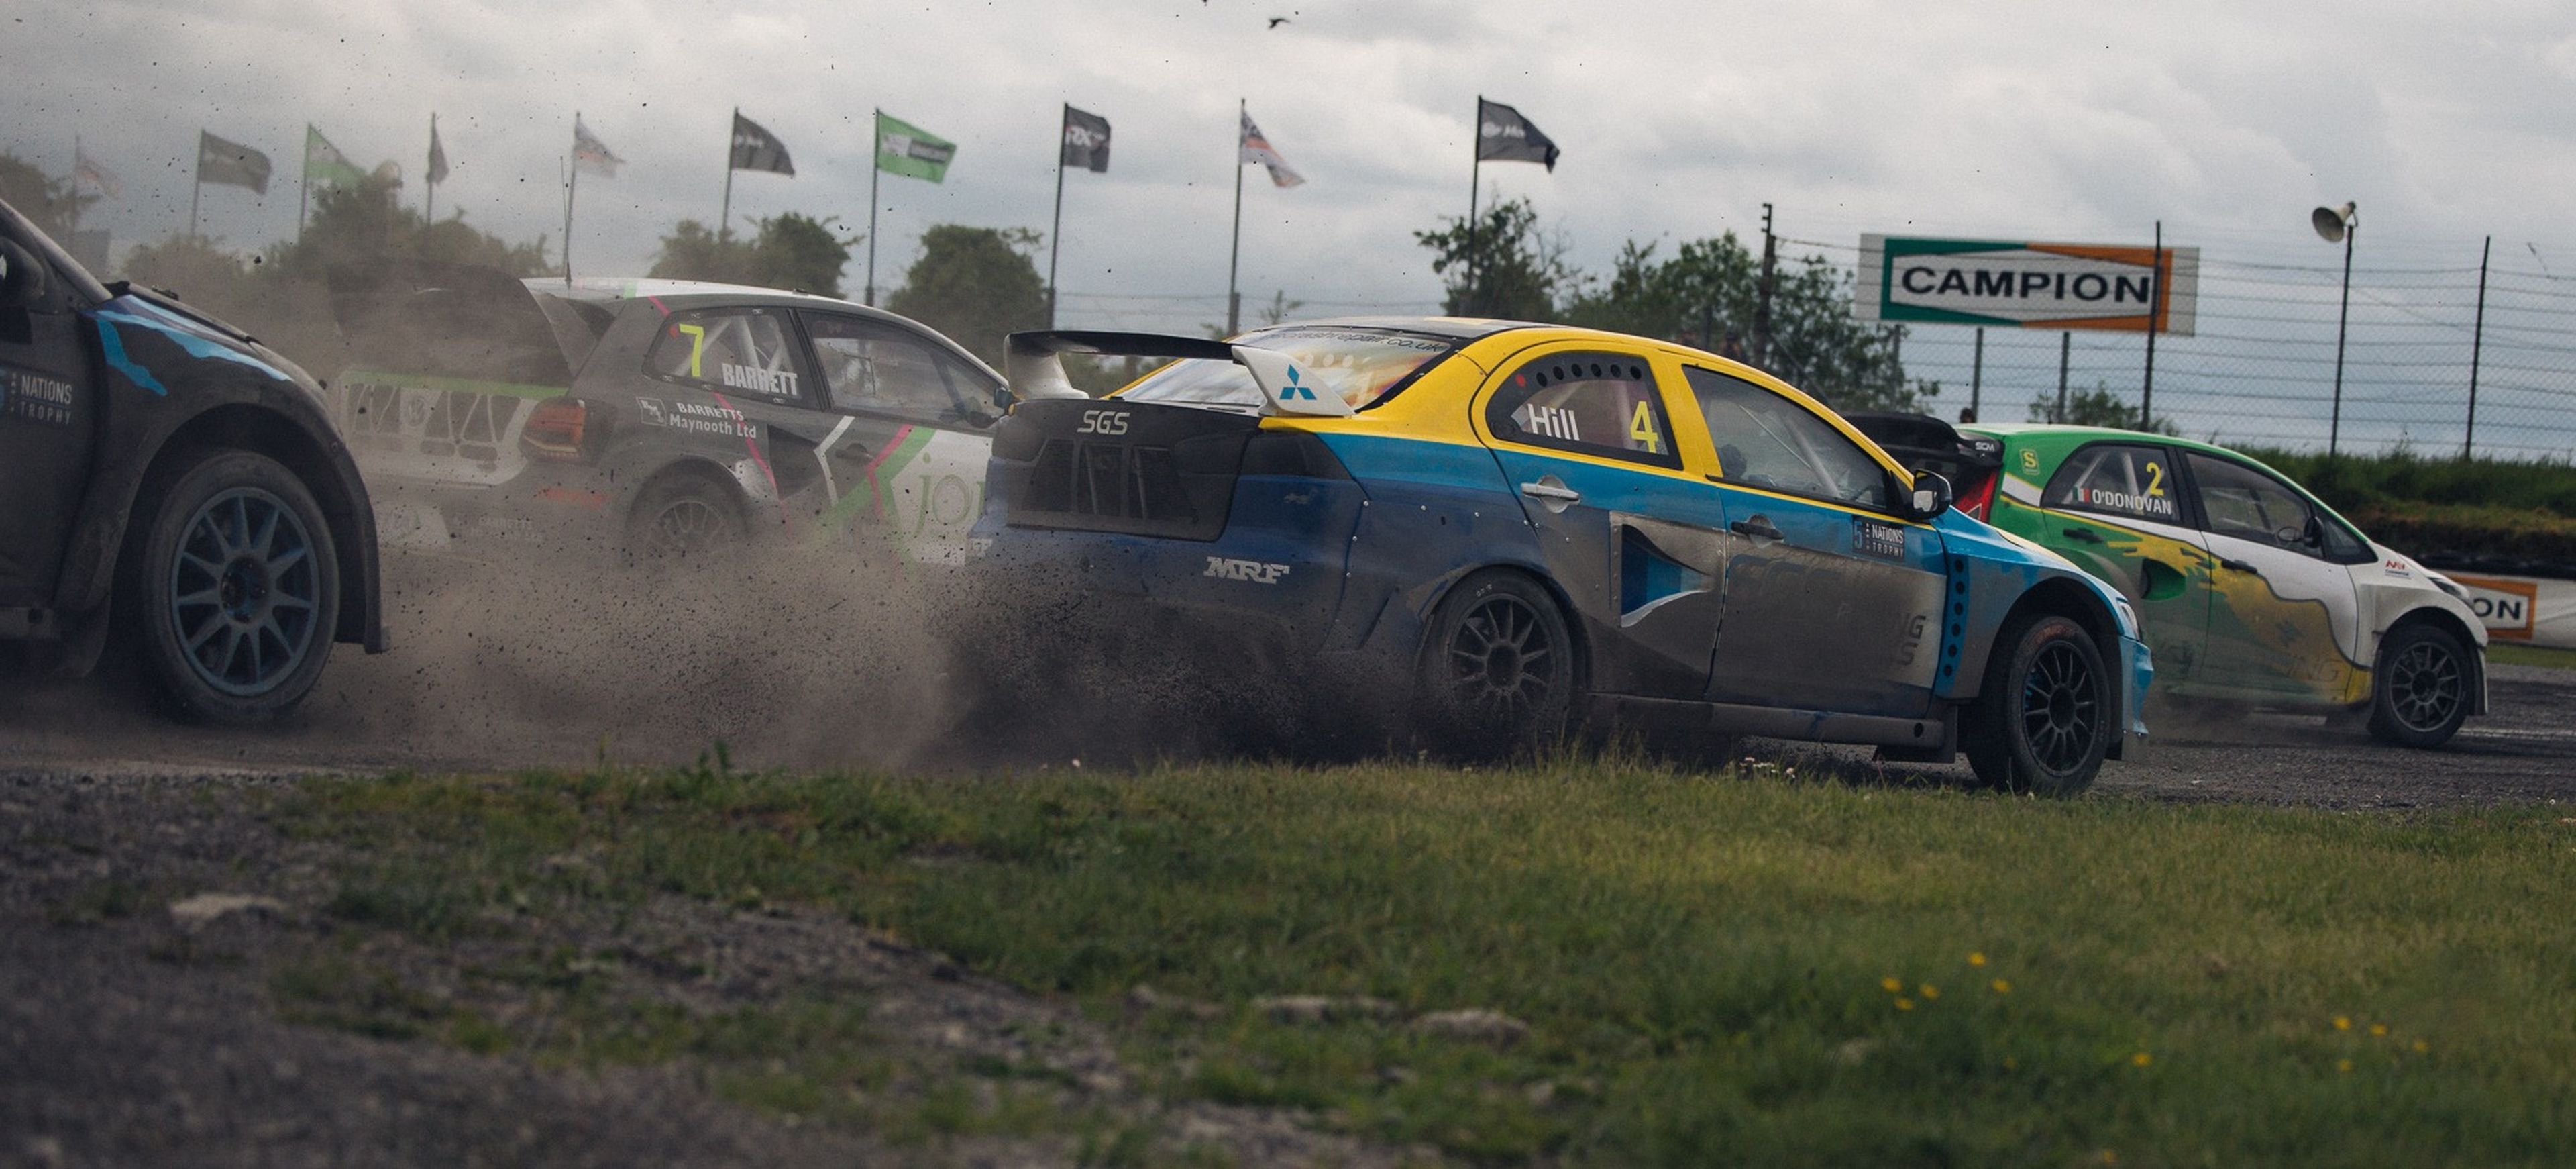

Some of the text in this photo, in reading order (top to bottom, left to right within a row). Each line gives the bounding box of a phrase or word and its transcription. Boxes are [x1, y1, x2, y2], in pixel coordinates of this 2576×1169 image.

[1901, 266, 2151, 303] CAMPION
[678, 323, 704, 377] 7
[21, 374, 72, 405] NATIONS
[722, 362, 798, 395] BARRETT
[21, 401, 71, 425] TROPHY
[670, 414, 757, 438] Maynooth Ltd
[676, 403, 745, 421] BARRETTS
[1076, 410, 1131, 435] SGS
[1527, 403, 1580, 441] Hill
[1630, 401, 1659, 454] 4
[2146, 462, 2164, 496] 2
[2092, 489, 2172, 515] O'DONOVAN
[1872, 524, 1904, 544] NATIONS
[1872, 542, 1904, 558] TROPHY
[1203, 556, 1291, 584] MRF
